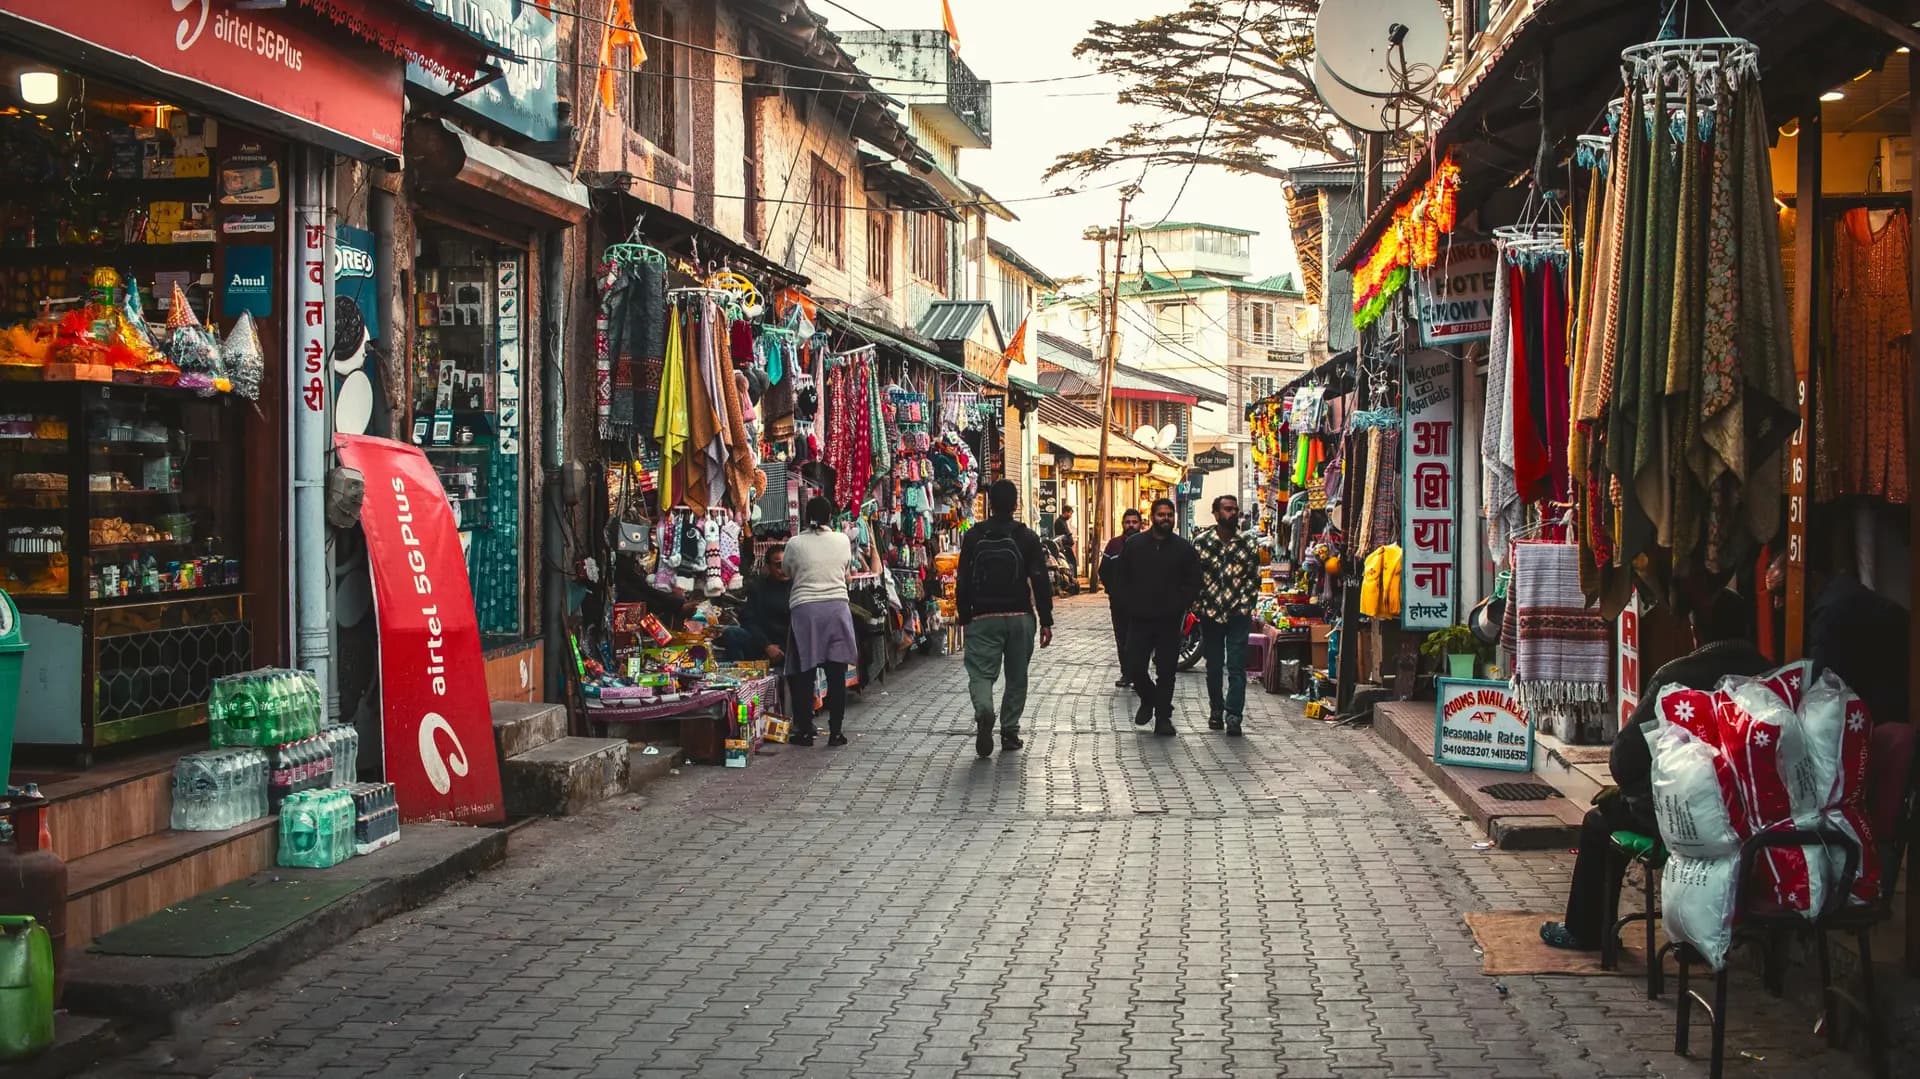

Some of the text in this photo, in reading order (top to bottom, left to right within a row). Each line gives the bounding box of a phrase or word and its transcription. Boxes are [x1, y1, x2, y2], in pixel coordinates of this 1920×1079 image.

[214, 9, 303, 72] airtel 5GPlus
[427, 0, 542, 90] MSUNG
[231, 273, 265, 286] Amul
[1435, 272, 1495, 297] HOTE
[1422, 300, 1478, 323] SNOW
[1406, 362, 1450, 384] Welcome
[1792, 457, 1803, 484] 16
[1412, 421, 1452, 597] आशियाना
[1791, 496, 1802, 523] 51
[1789, 535, 1801, 562] 51
[421, 604, 447, 696] airtel
[1443, 691, 1476, 722] ROOMS
[1469, 711, 1498, 724] AT
[1442, 726, 1526, 745] Reasonable Rates
[471, 802, 495, 815] House
